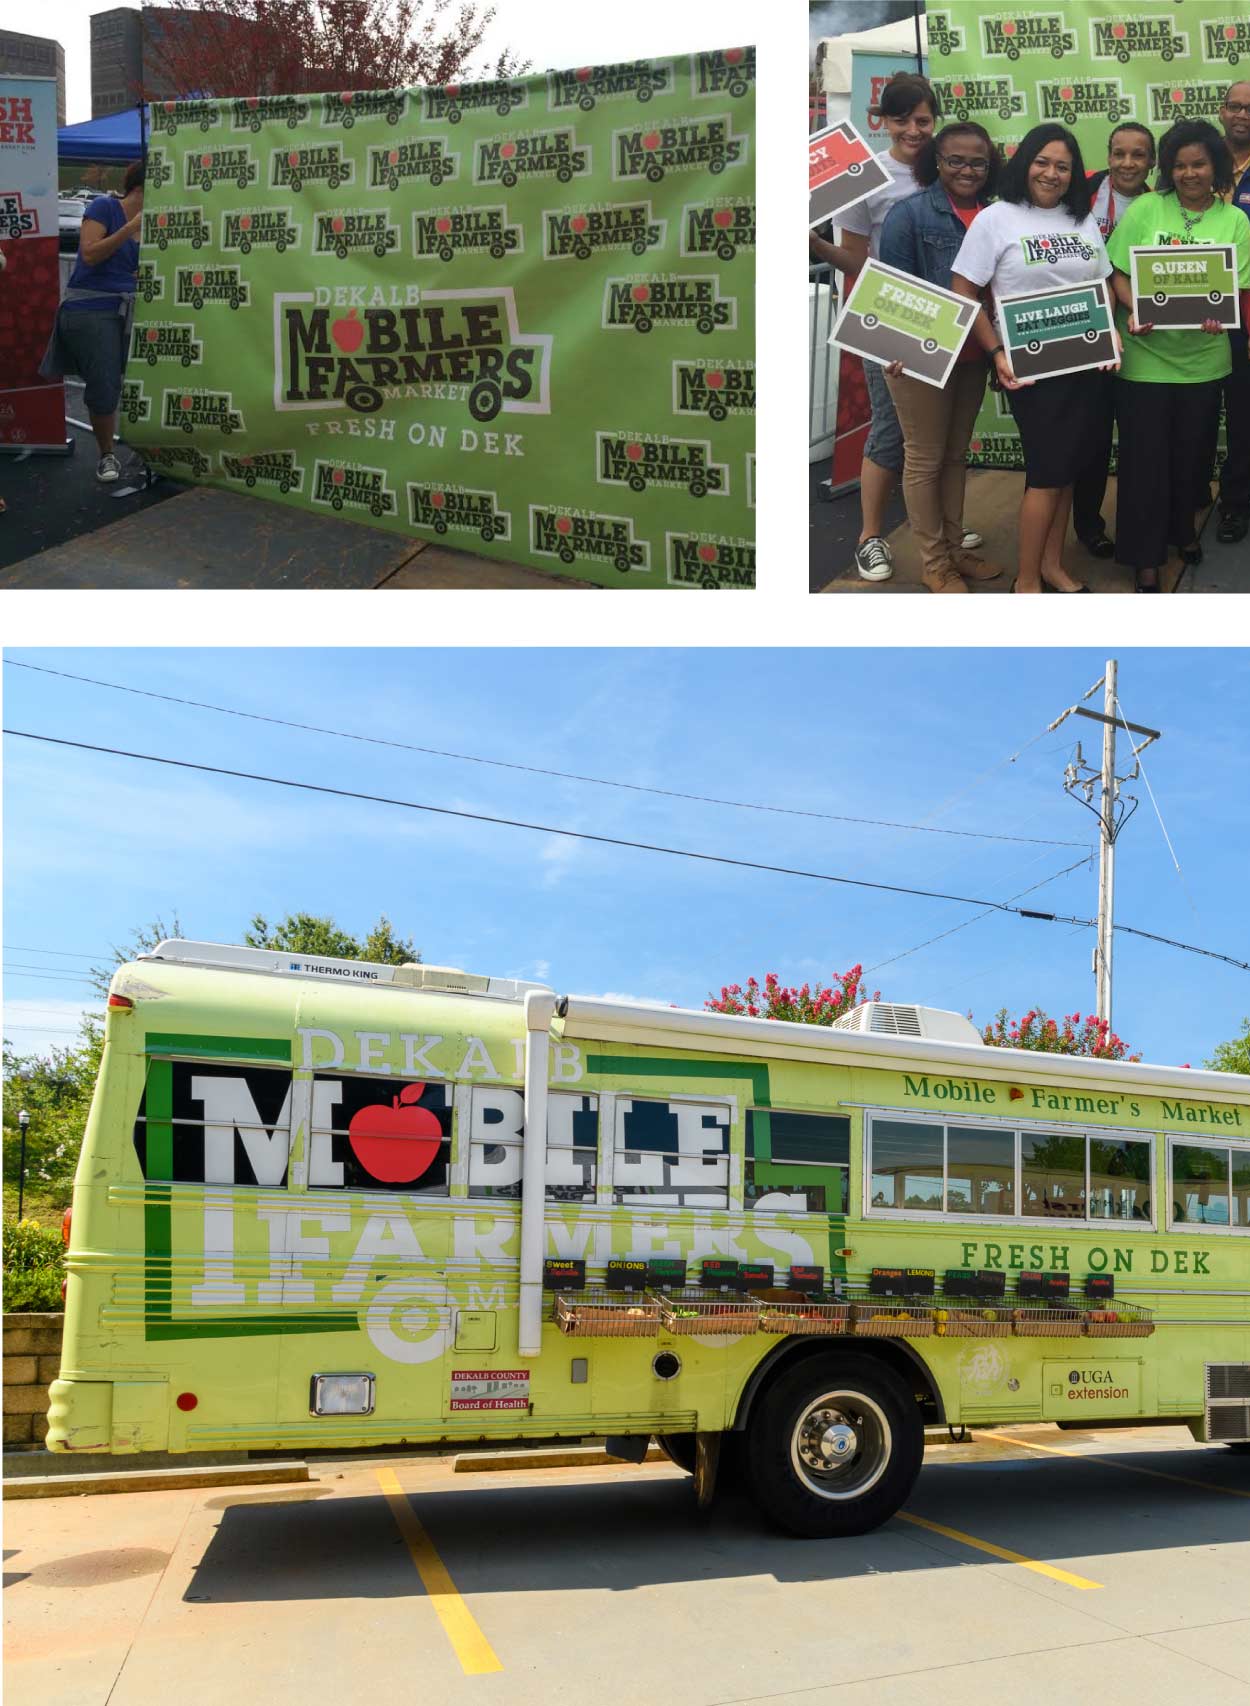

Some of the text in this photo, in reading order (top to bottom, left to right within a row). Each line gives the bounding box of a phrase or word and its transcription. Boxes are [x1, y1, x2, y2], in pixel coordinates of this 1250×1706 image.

[1104, 37, 1184, 55] FARMERS
[629, 141, 741, 175] FARMERS
[557, 224, 661, 254] FARMERS
[1034, 245, 1094, 260] FARMERS
[1151, 260, 1208, 275] QUEEN
[1153, 272, 1209, 285] OF KALE
[315, 285, 420, 307] DEKALB
[878, 282, 942, 319] FRESH
[617, 302, 729, 325] FARMERS
[873, 296, 935, 330] ON DEK
[1015, 301, 1089, 324] LIVE LAUGH
[1016, 319, 1040, 333] EAT
[1042, 311, 1090, 329] VEGGIES
[304, 349, 534, 400] FARMERS
[382, 384, 470, 401] MARKET
[305, 418, 525, 456] FRESH ON DEK
[612, 460, 722, 490] FARMERS
[545, 533, 643, 565] FARMERS
[304, 964, 378, 979] THERMO KING
[299, 1028, 584, 1083] DEKAB
[904, 1075, 1242, 1127] Mobile Farmer's Market
[546, 1261, 574, 1269] Sweet
[610, 1261, 646, 1270] ONIONS
[961, 1243, 1211, 1275] FRESH ON DEK
[454, 1372, 527, 1380] DEKALB COUNTY
[1081, 1371, 1113, 1384] UGA
[1068, 1386, 1129, 1400] extension
[452, 1400, 526, 1410] Board of Health
